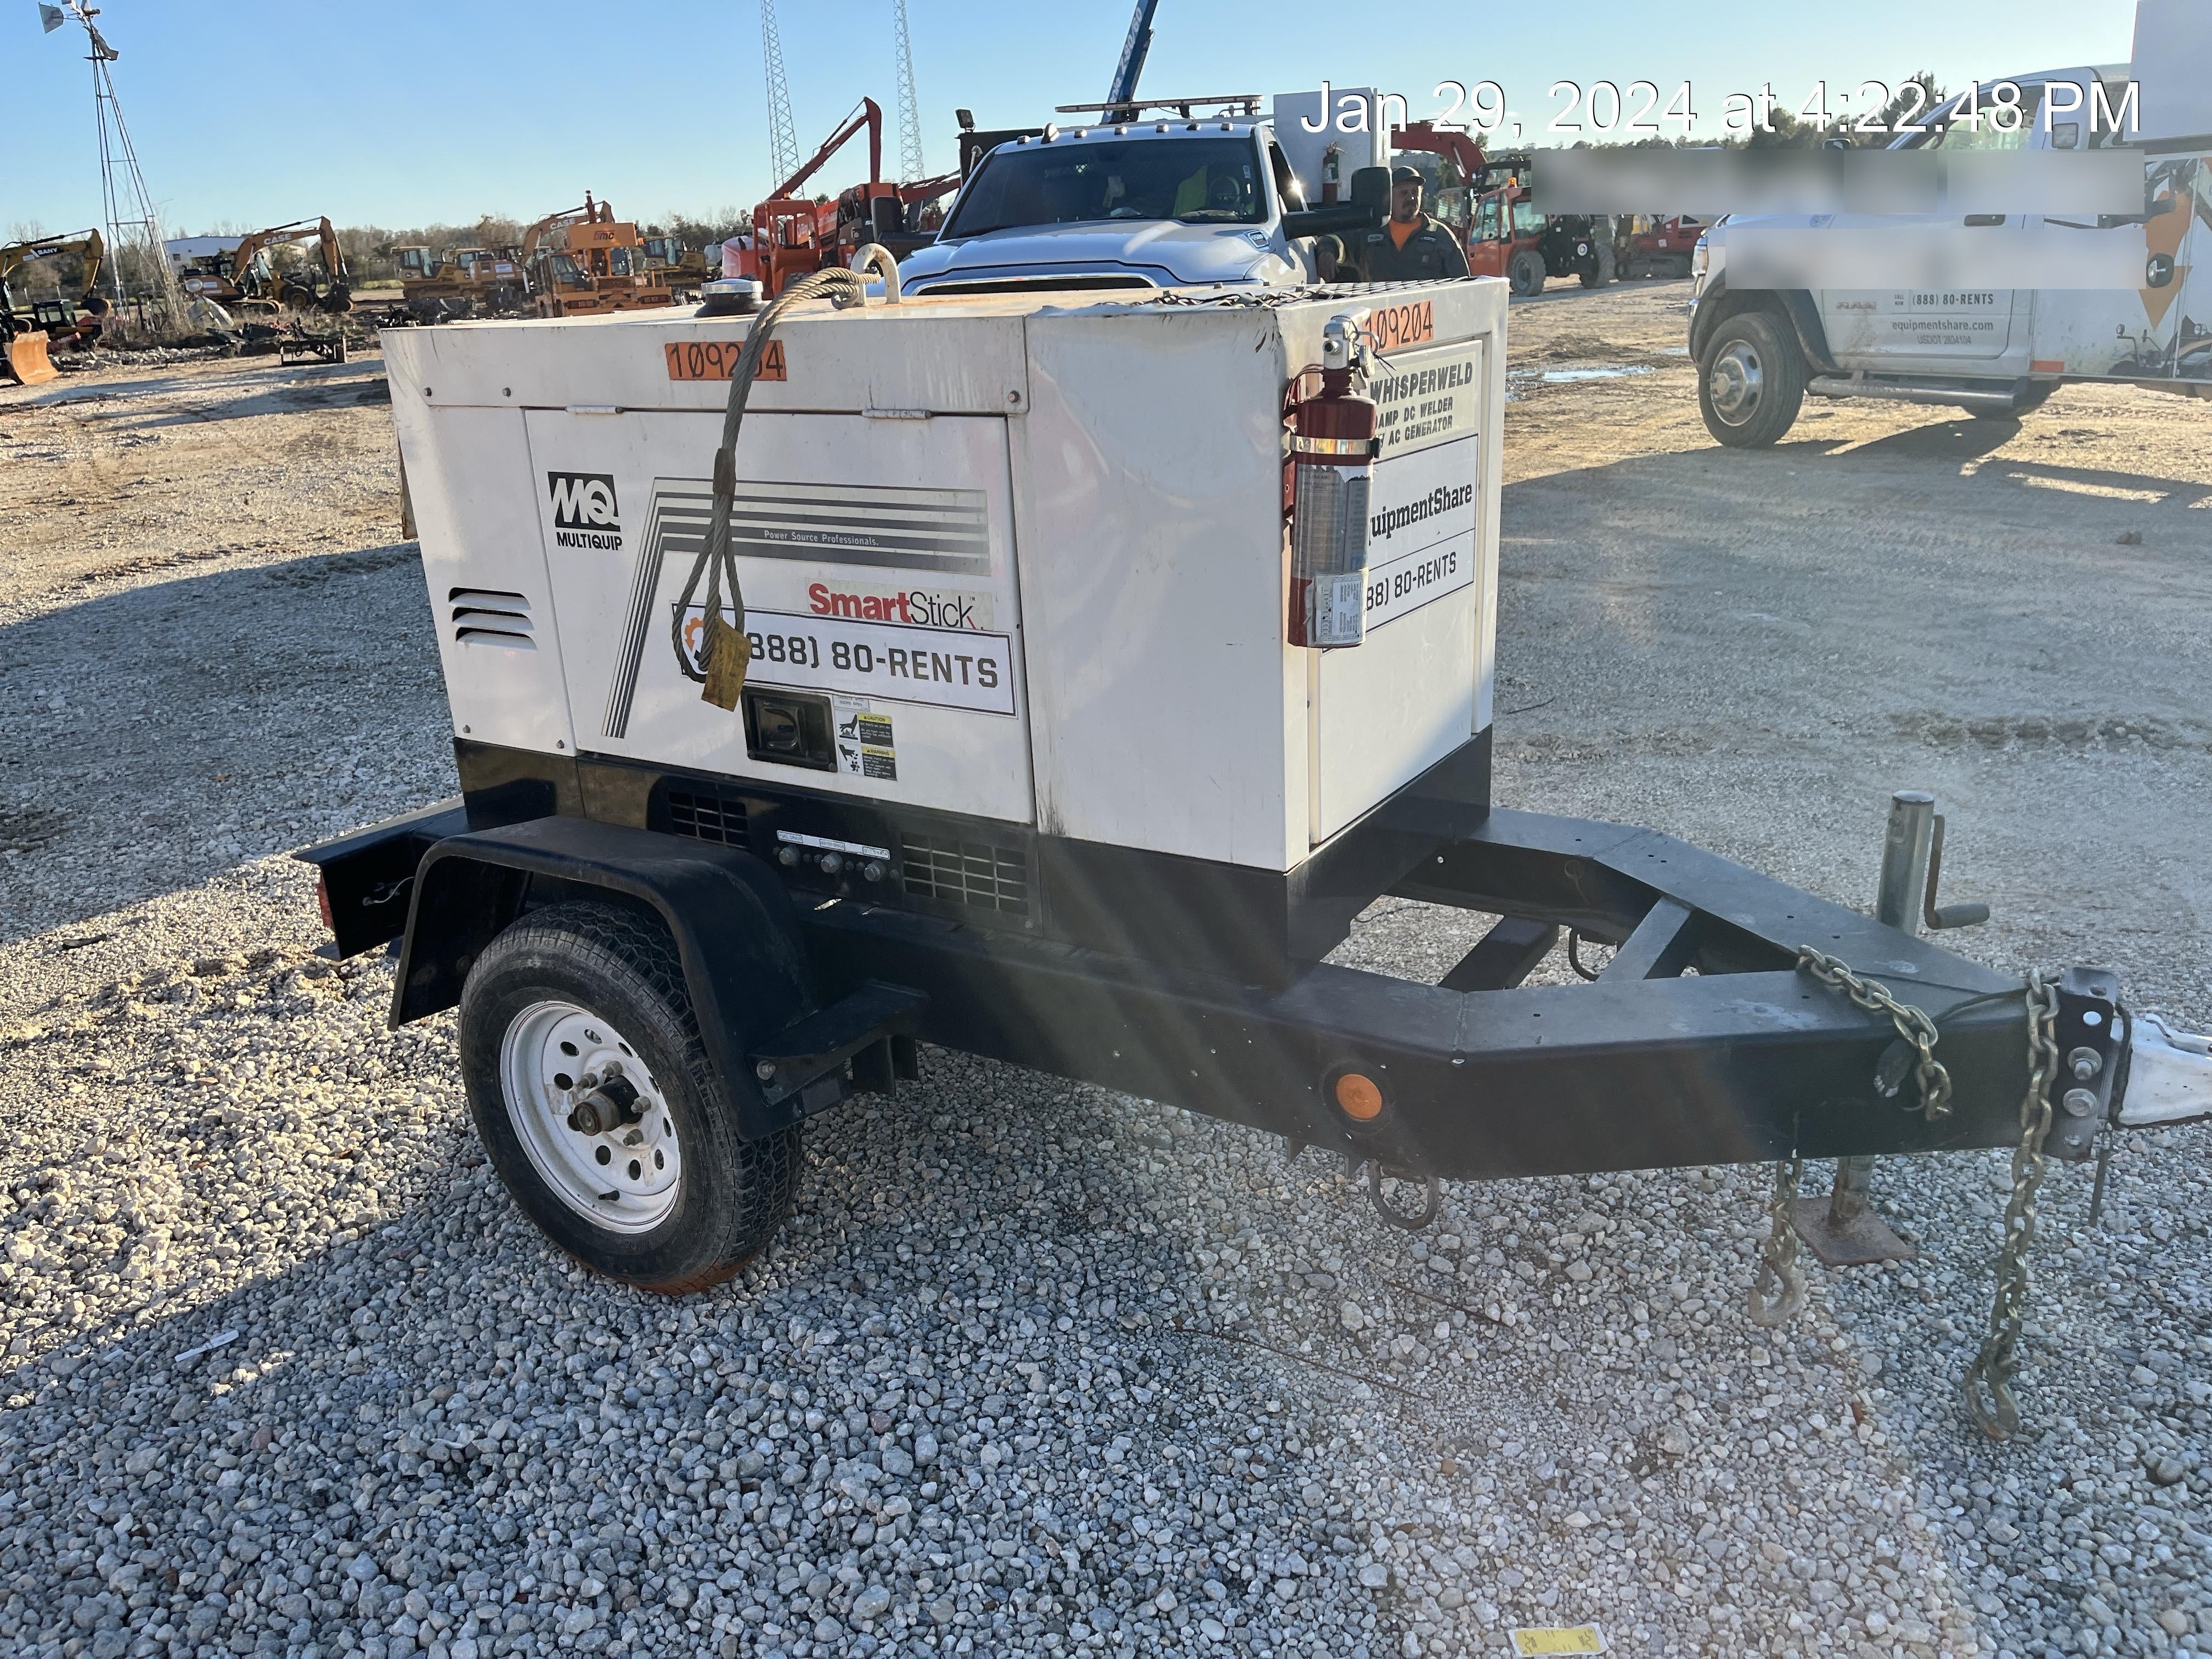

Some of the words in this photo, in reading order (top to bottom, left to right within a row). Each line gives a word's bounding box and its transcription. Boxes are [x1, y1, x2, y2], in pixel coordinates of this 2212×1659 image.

[550, 218, 575, 229] CASE
[263, 233, 292, 245] CASE
[1912, 294, 1938, 306] (888)
[1943, 294, 1994, 304] 80-RENTS
[1892, 319, 1993, 331] equipmentshare.com
[1370, 362, 1473, 405] WHISPERWELD
[1403, 406, 1416, 422] DC
[1420, 396, 1454, 418] WELDER
[1389, 432, 1401, 447] AC
[1404, 415, 1454, 441] GENERATOR
[550, 476, 620, 526] MQ
[556, 532, 622, 551] MULTIQUIP
[764, 529, 788, 539] Power
[791, 531, 819, 542] Source
[822, 533, 879, 546] Professionals.
[1394, 551, 1457, 598] 80-RENTS
[832, 641, 998, 688] 80-RENTS
